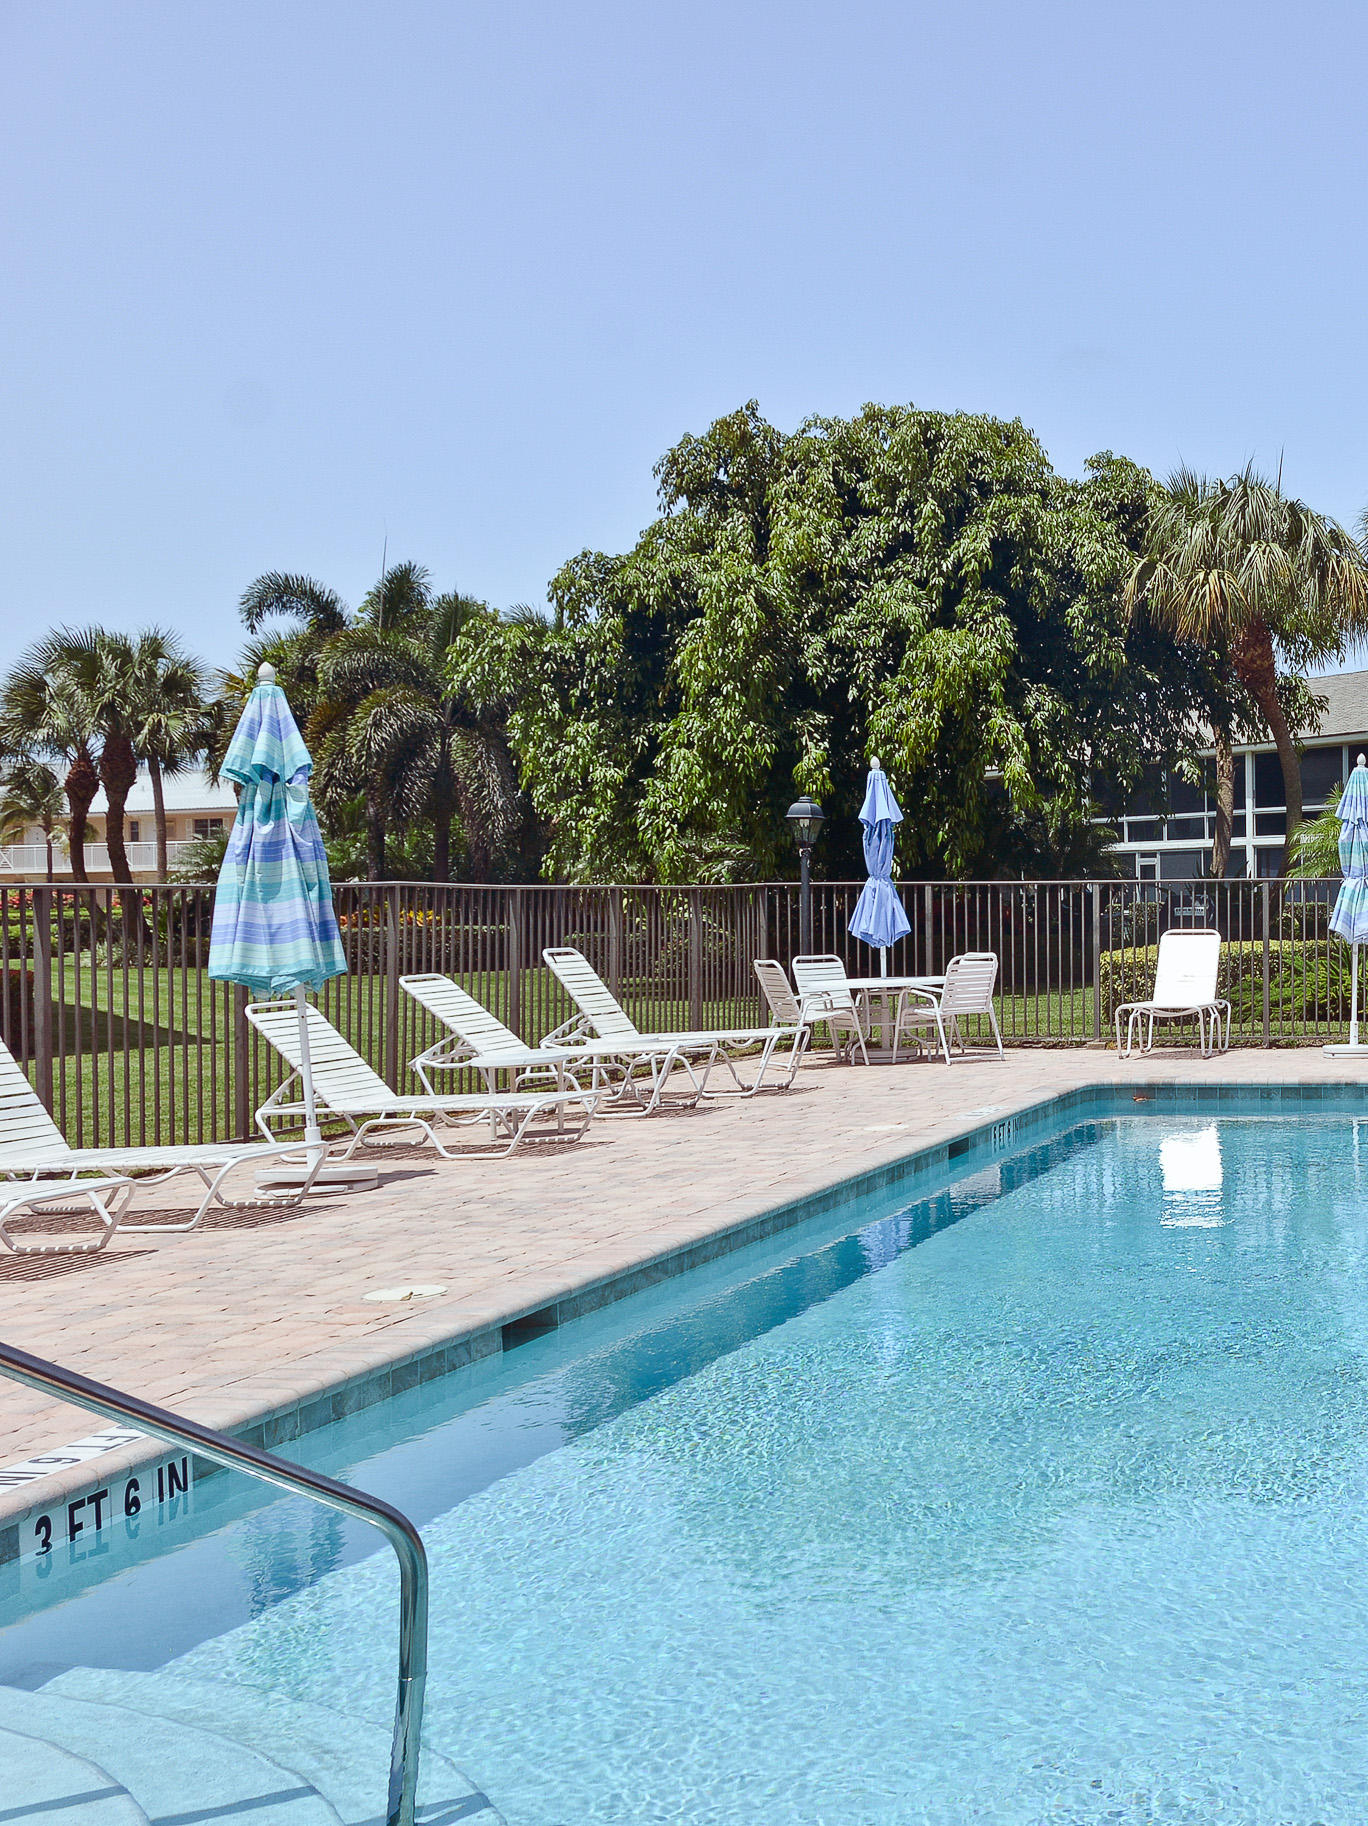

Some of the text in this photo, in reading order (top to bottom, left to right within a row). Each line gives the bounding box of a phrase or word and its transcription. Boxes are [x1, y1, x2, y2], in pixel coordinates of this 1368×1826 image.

[67, 1434, 141, 1452] FT
[28, 1457, 81, 1465] 6
[35, 1456, 188, 1556] 3 FT 6 IN
